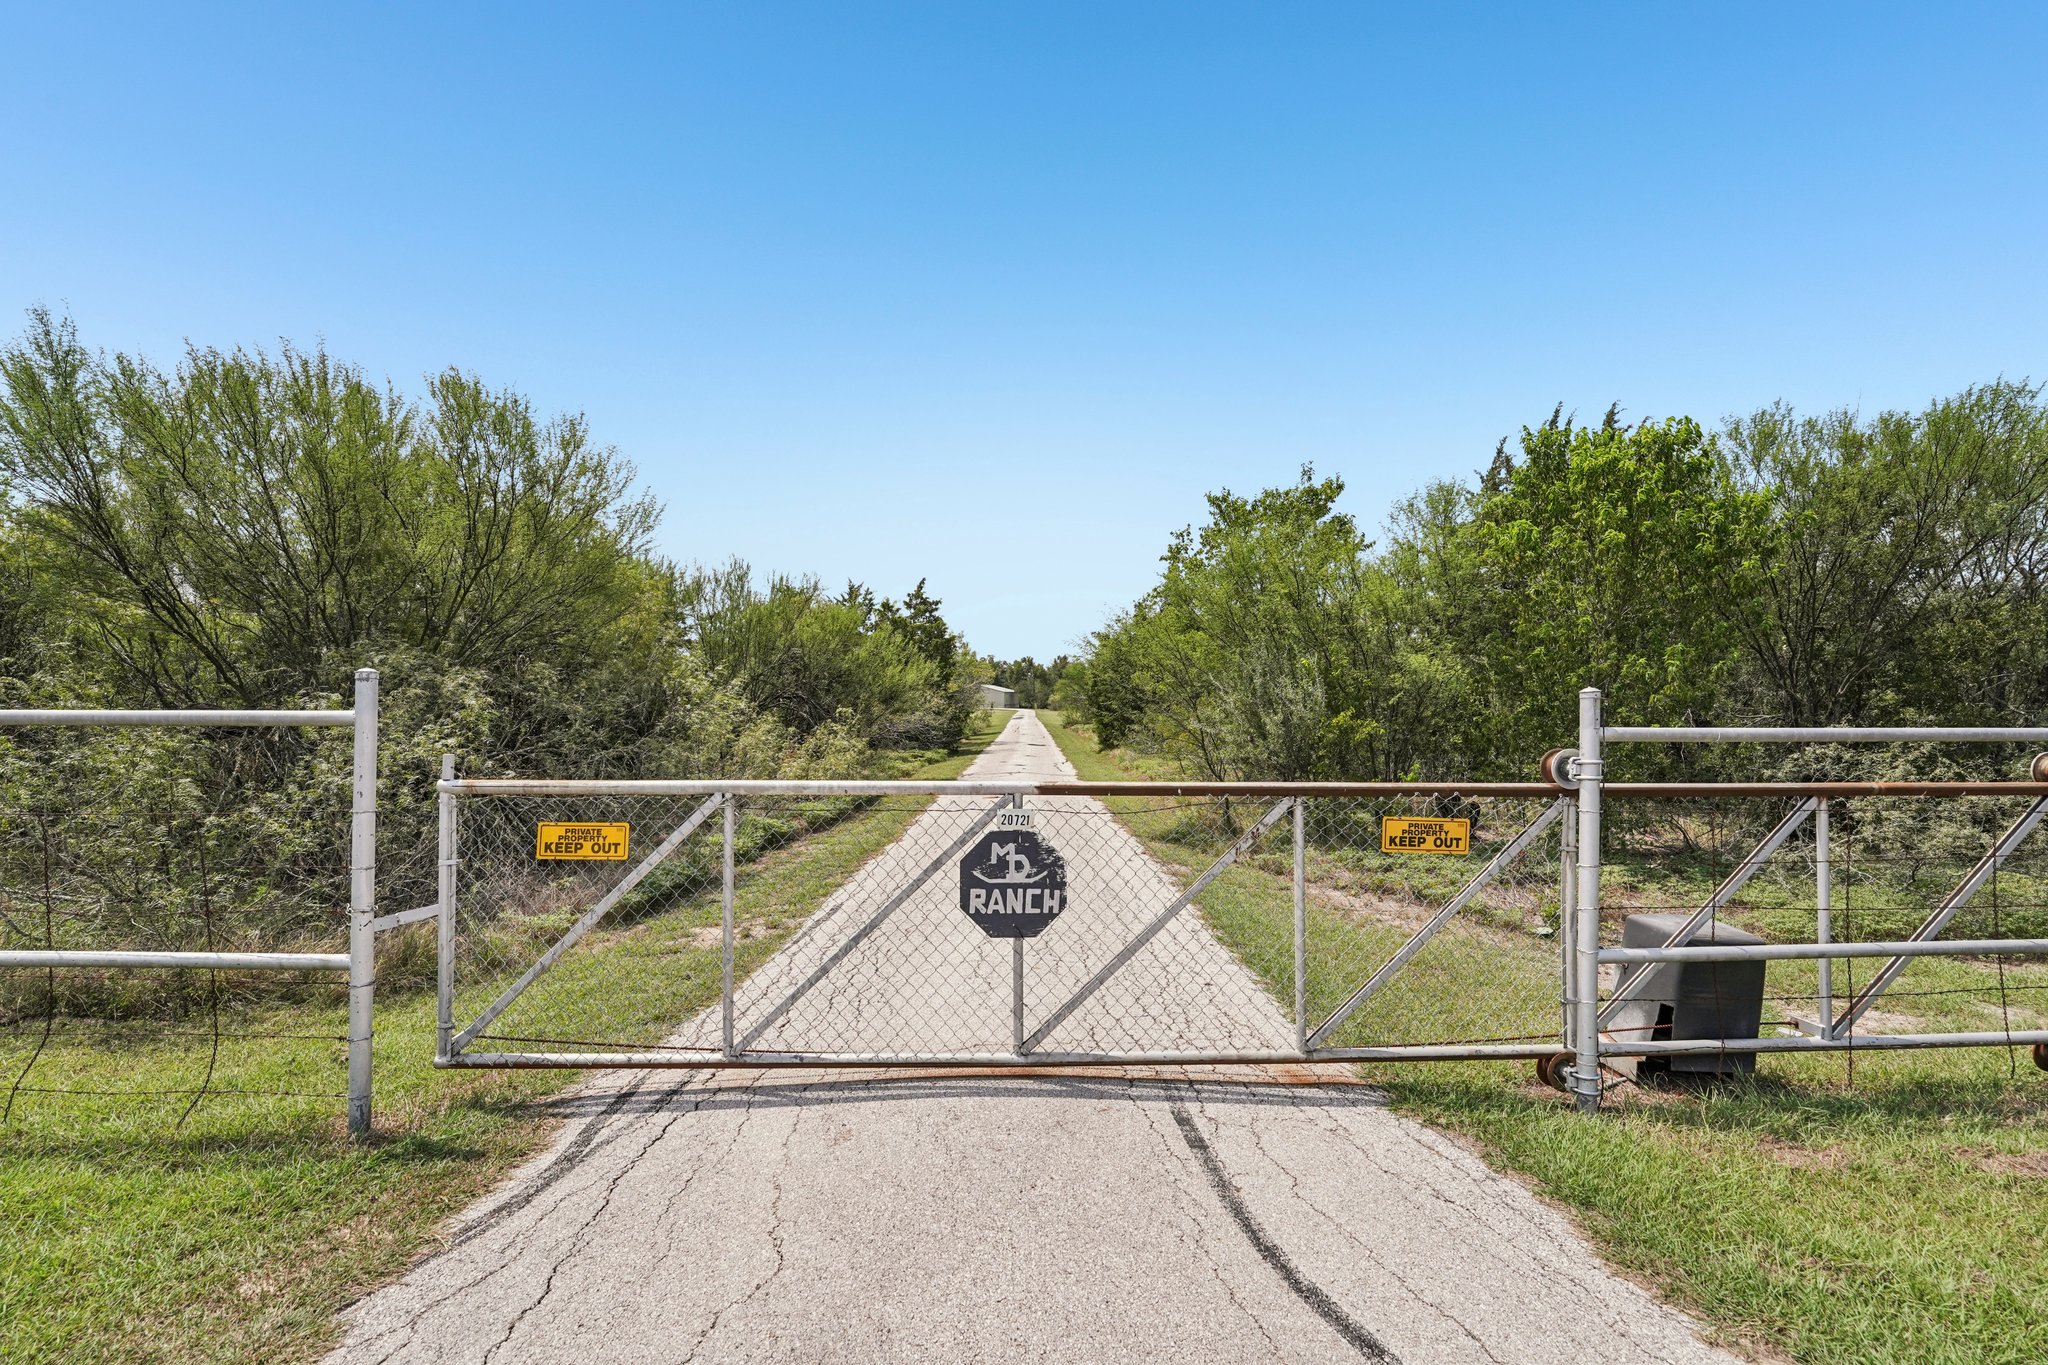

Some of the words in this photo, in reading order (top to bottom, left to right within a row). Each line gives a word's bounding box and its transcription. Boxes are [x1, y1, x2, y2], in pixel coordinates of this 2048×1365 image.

[1000, 814, 1030, 826] 20721
[565, 828, 602, 836] PRIVATE
[1402, 829, 1450, 837] PROPERTY
[544, 842, 584, 854] KEEP
[591, 842, 621, 854] OUT
[1389, 836, 1426, 847] KEEP
[1434, 837, 1462, 849] OUT
[969, 888, 1061, 914] RANCH
